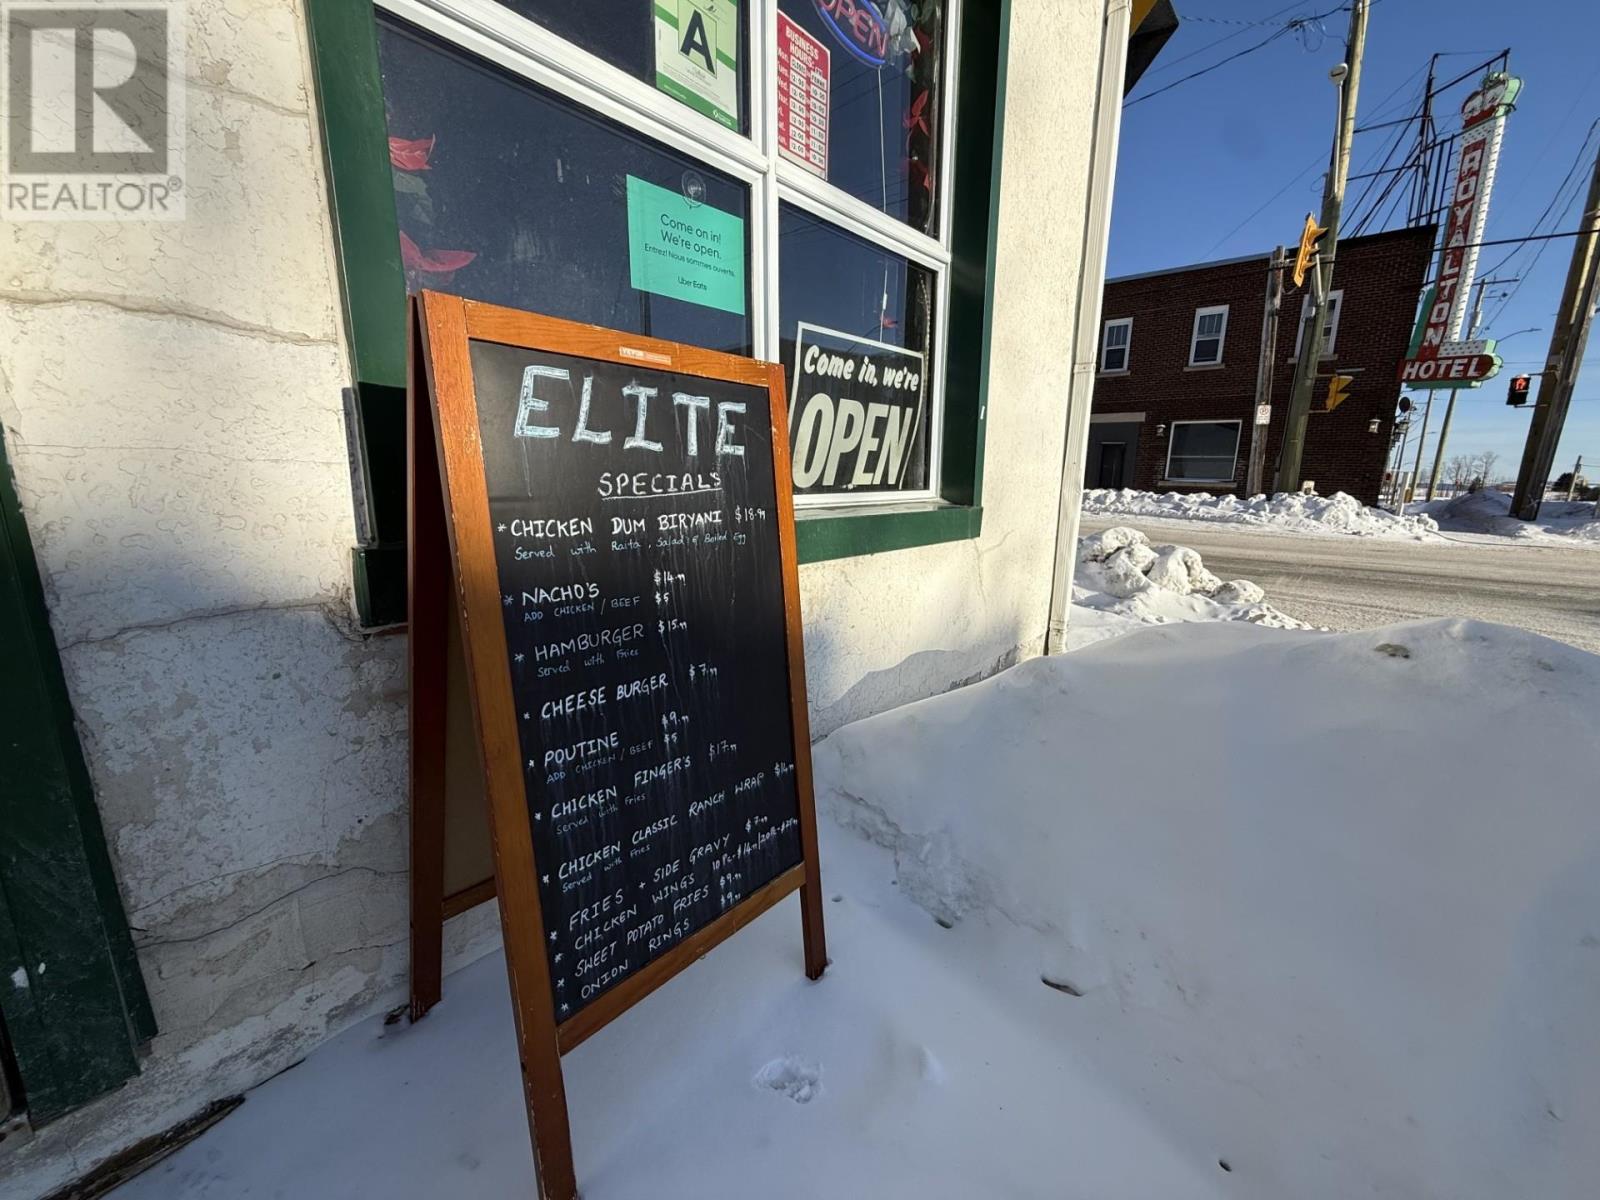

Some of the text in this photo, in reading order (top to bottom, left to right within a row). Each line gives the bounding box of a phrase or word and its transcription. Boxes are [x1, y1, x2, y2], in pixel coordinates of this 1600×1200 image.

[680, 9, 716, 75] A
[785, 25, 819, 60] BUSINESS
[660, 213, 722, 244] Come on in!
[661, 229, 722, 260] We're open.
[1423, 148, 1479, 347] ROYALTON
[668, 250, 686, 263] Nous
[686, 257, 712, 270] sommes
[678, 275, 708, 291] Uber Eats
[804, 345, 919, 391] Come in, we're
[1402, 357, 1481, 380] HOTEL
[514, 364, 746, 457] ELITE
[792, 392, 913, 488] OPEN
[597, 471, 722, 497] SPECIALS
[510, 517, 593, 538] CHICKEN
[610, 516, 645, 535] DUM
[657, 510, 723, 531] BIRYANI
[514, 546, 554, 561] Served
[571, 541, 597, 557] with
[704, 531, 728, 543] Boiled
[733, 532, 746, 545] Egg
[522, 583, 600, 606] NACHO'S
[524, 610, 543, 622] ADD
[554, 603, 594, 618] CHICKEN
[610, 596, 640, 609] BEEF
[535, 623, 644, 661] HAMBURGER
[537, 660, 571, 678] Served
[584, 652, 605, 667] with
[541, 686, 607, 718] CHEESE
[616, 673, 668, 700] BURGER
[544, 731, 620, 768] POUTINE
[546, 771, 566, 784] ADD
[575, 753, 616, 774] CHICKEN
[629, 739, 654, 756] BEEF
[551, 785, 617, 818] CHICKEN
[634, 755, 692, 789] FINGER'S
[556, 792, 646, 835] Served with Fries
[558, 841, 621, 880] CHICKEN
[632, 814, 678, 845] CLASSIC
[688, 789, 725, 818] RANCH
[734, 771, 765, 796] WRAP
[562, 843, 651, 893] Served with Fries
[569, 888, 624, 931] FRIES
[653, 859, 680, 883] SIDE
[689, 833, 730, 865] GRAVY
[575, 904, 638, 950] CHICKEN
[575, 941, 617, 977] SWEET
[627, 914, 664, 945] POTATO
[673, 884, 709, 915] FRIES
[581, 960, 628, 999] ONION
[649, 918, 690, 952] RINGS
